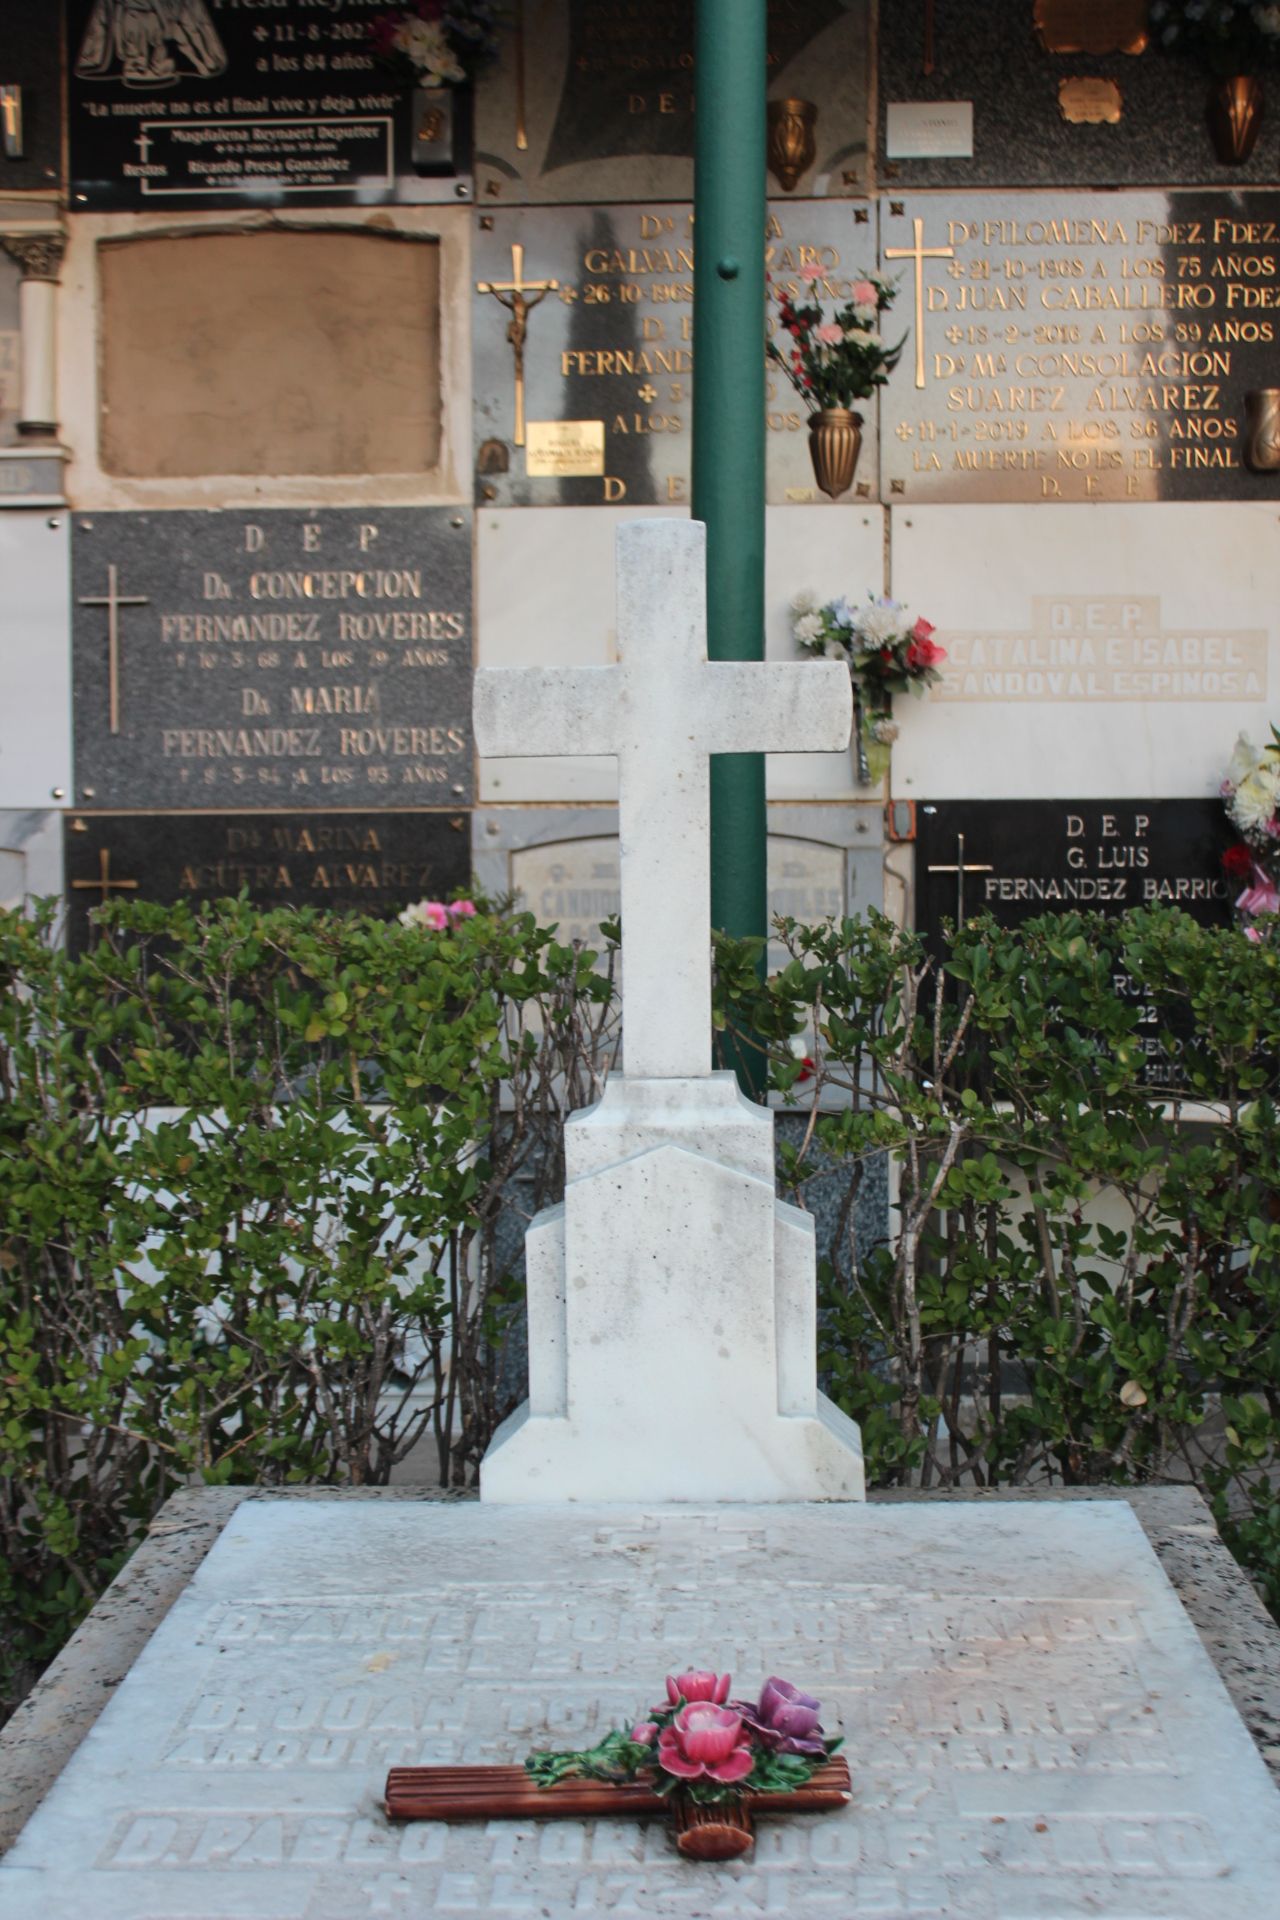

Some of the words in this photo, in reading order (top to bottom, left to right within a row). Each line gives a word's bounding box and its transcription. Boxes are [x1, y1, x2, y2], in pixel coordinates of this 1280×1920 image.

[256, 57, 269, 72] a
[272, 54, 300, 71] los
[303, 54, 326, 71] 84
[330, 52, 375, 71] años
[111, 102, 167, 116] muerte
[169, 103, 190, 115] no
[193, 102, 212, 114] es
[214, 98, 230, 114] el
[232, 98, 270, 114] final
[271, 98, 305, 113] vive
[320, 95, 356, 114] deja
[187, 160, 242, 175] Ricardo
[244, 159, 284, 174] Presa
[981, 218, 1129, 246] FILOMENA
[1091, 259, 1108, 280] A
[1120, 257, 1167, 280] LOS
[1176, 256, 1201, 278] 75
[1210, 252, 1276, 278] AÑOS
[955, 285, 1028, 311] JUAN
[1040, 284, 1216, 311] CABALLERO
[1090, 323, 1108, 344] A
[1119, 322, 1166, 344] LOS
[1208, 316, 1275, 344] AÑOS
[1014, 349, 1232, 378] CONSOLACIÓN
[946, 385, 1066, 412] SUAREZ
[611, 414, 630, 434] A
[634, 412, 683, 433] LOS
[1041, 421, 1058, 441] A
[1068, 419, 1120, 441] LOS
[1169, 415, 1239, 440] AÑOS
[911, 449, 944, 472] LA
[952, 448, 1046, 471] MUERTE
[1057, 449, 1089, 470] NO
[1095, 449, 1124, 470] ES
[1133, 447, 1163, 470] EL
[1170, 447, 1240, 469] FINAL
[603, 476, 628, 502] D
[249, 569, 422, 600] CONCEPCION
[160, 613, 321, 643] FERNANDEZ
[338, 611, 465, 641] ROVERES
[294, 651, 308, 669] A
[321, 650, 355, 669] LOS
[402, 648, 450, 667] AÑOS
[947, 637, 1097, 667] CATALINA
[1105, 637, 1125, 665] E
[1133, 637, 1244, 666] ISABEL
[939, 671, 1106, 697] SANDOVAL
[1112, 671, 1262, 696] ESPINOSA
[290, 686, 381, 715] MARIA
[160, 729, 323, 758] FERNANDEZ
[339, 727, 466, 756] ROVERES
[320, 765, 354, 784] LOS
[402, 763, 450, 784] AÑOS
[1098, 845, 1150, 869] LUIS
[984, 877, 1128, 901] FERNANDEZ
[273, 1697, 471, 1733] JUAN
[884, 1821, 1211, 1868] FRANCO
